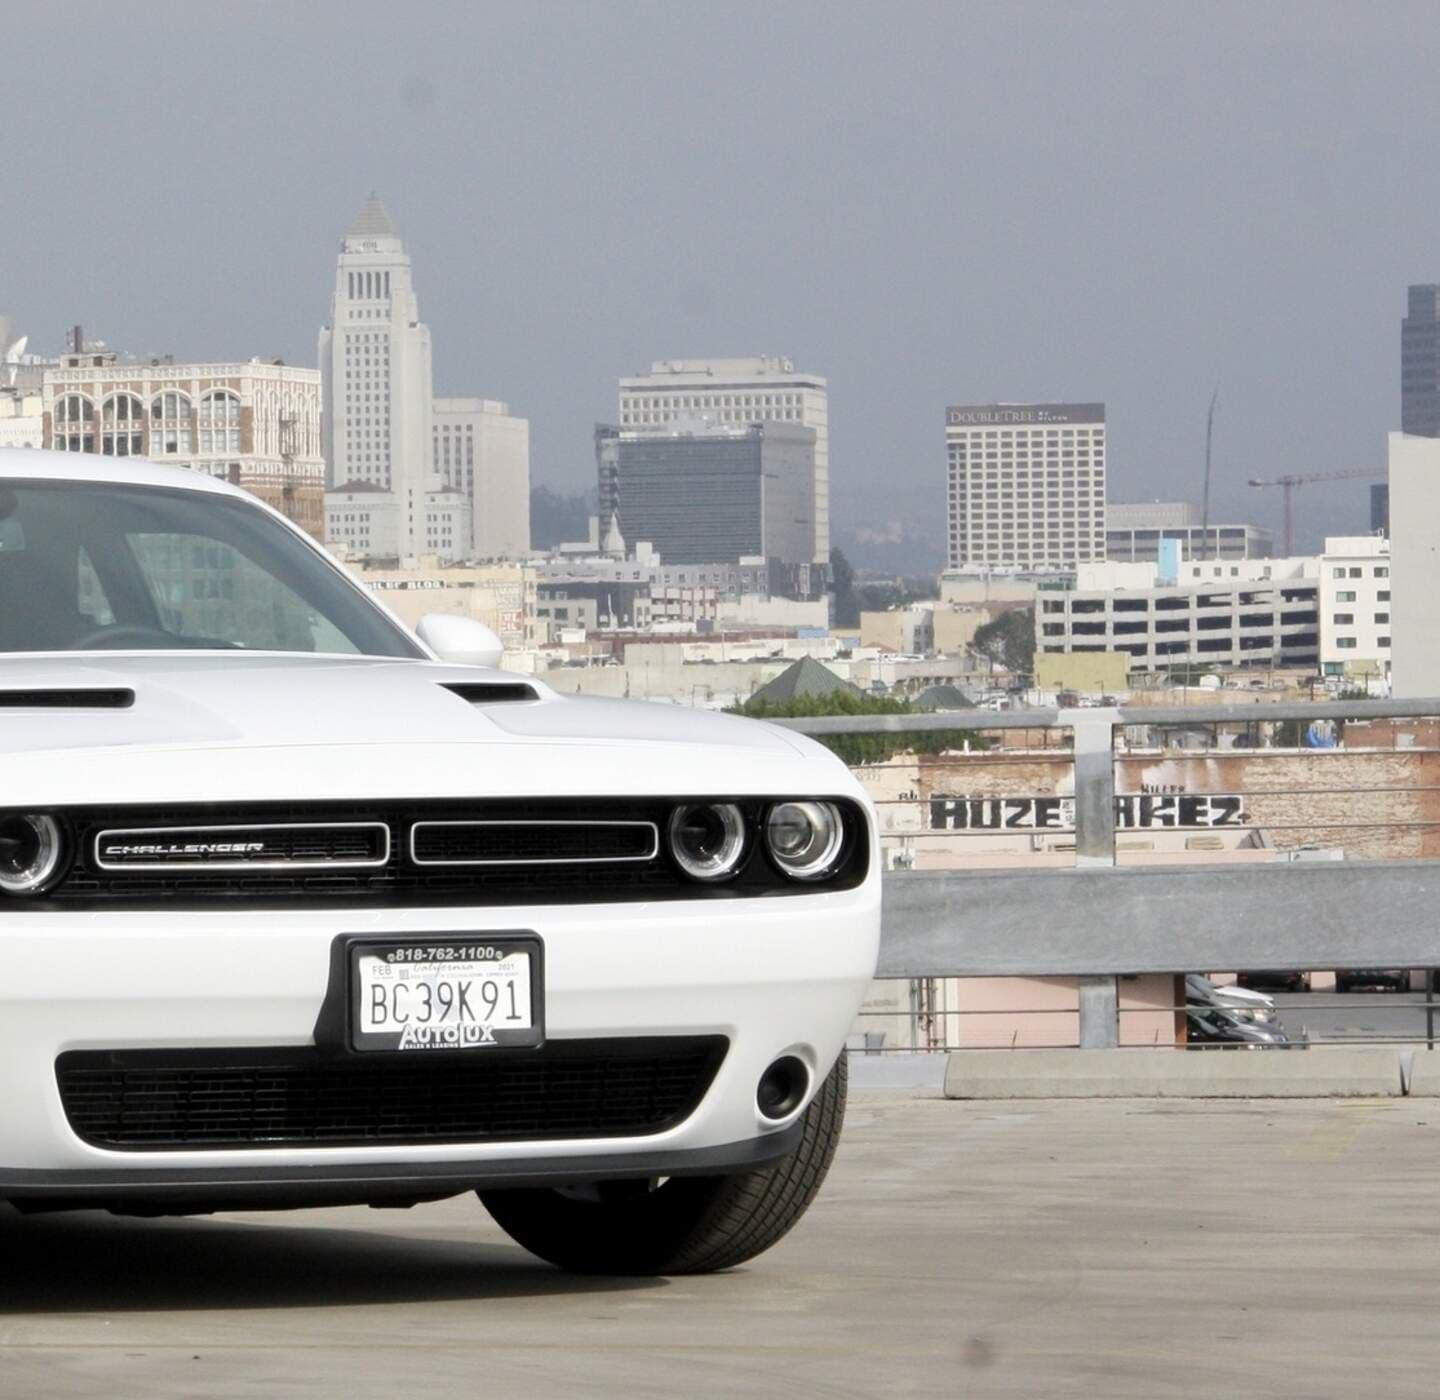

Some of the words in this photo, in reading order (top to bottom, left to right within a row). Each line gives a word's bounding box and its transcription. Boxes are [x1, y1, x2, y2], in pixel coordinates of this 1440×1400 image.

[106, 843, 264, 854] CHALLENGER
[396, 947, 495, 961] 818-762-1100
[372, 965, 392, 976] FEB
[413, 962, 474, 977] California
[371, 980, 522, 1025] BC39K91
